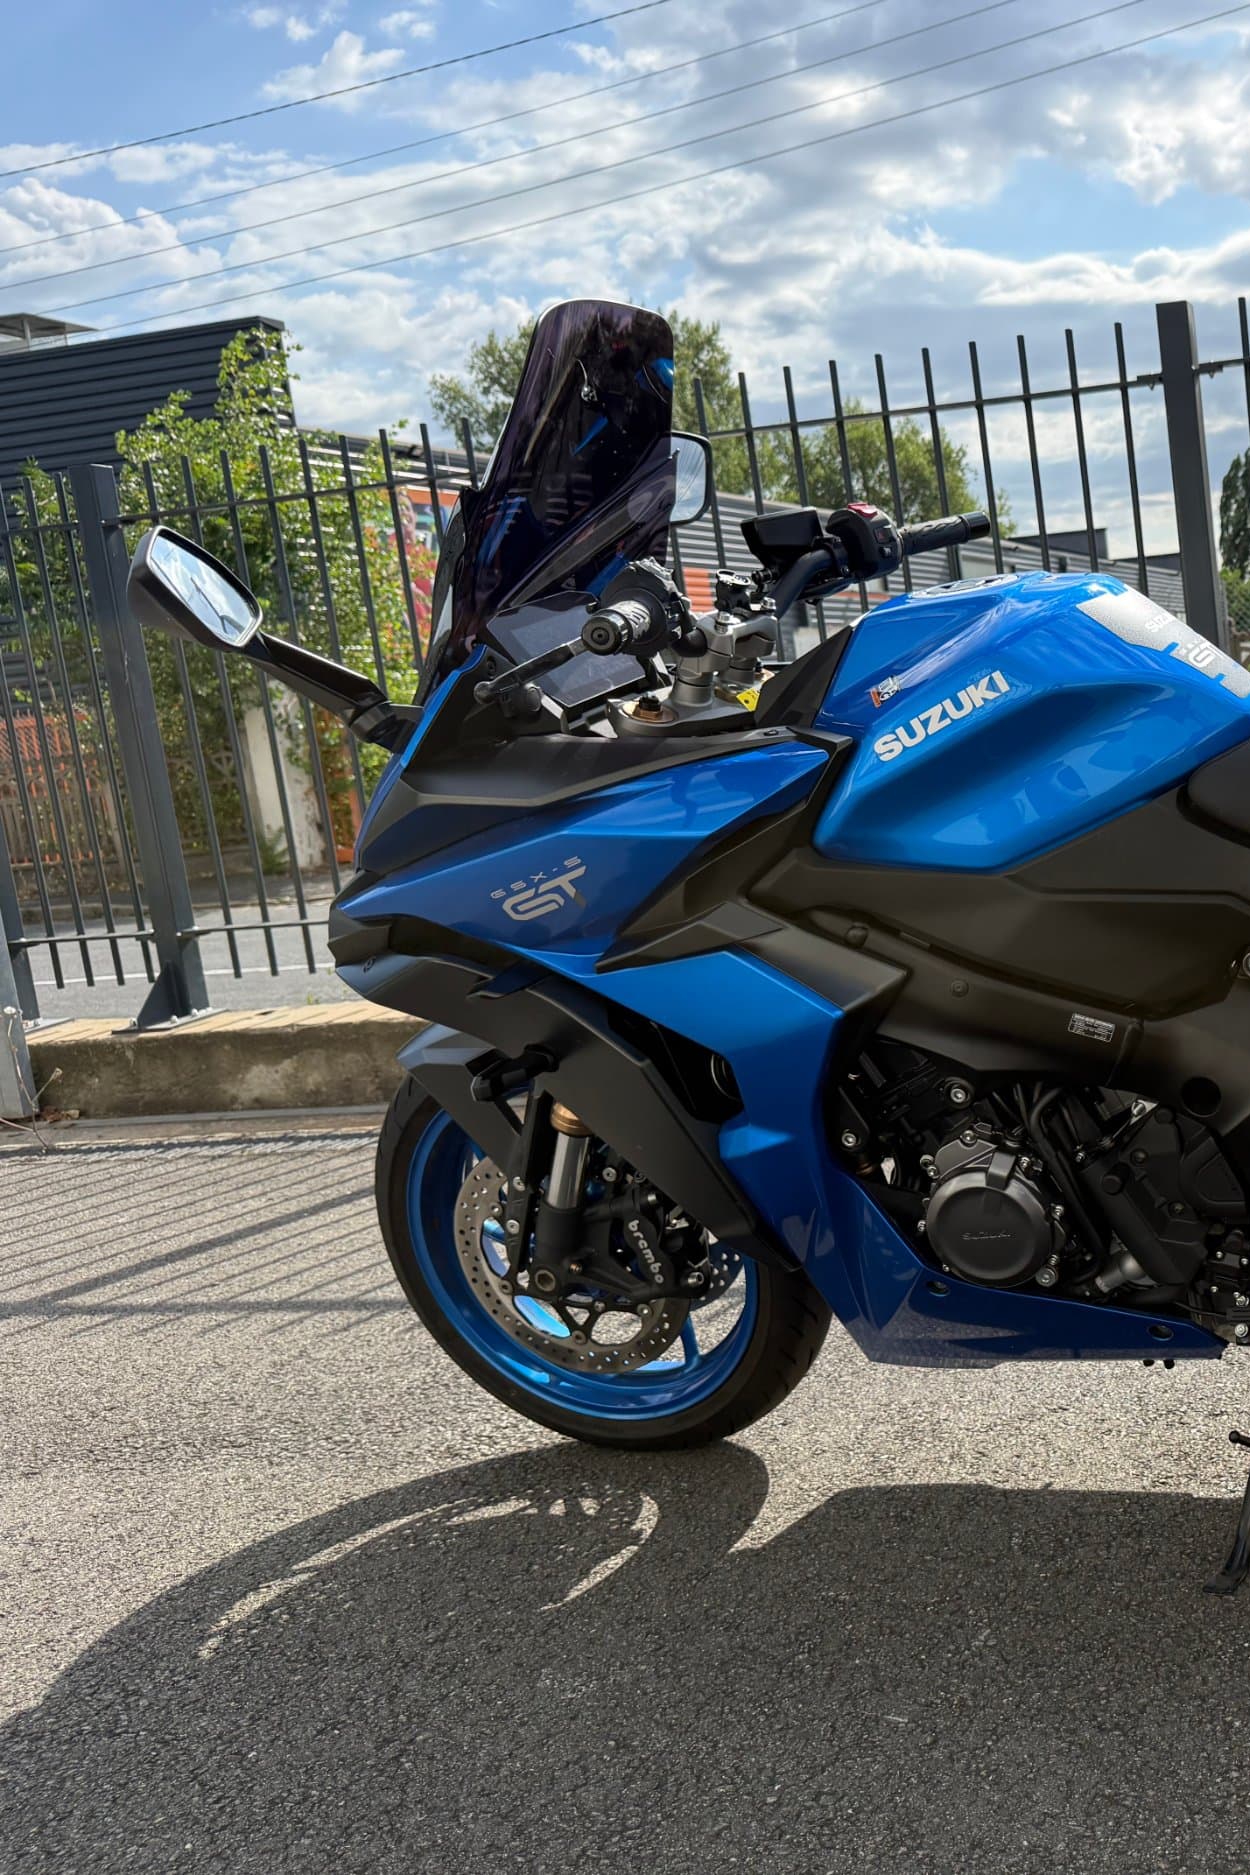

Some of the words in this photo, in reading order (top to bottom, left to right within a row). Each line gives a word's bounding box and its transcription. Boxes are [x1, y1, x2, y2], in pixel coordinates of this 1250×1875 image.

[873, 669, 1010, 762] SUZUKI
[490, 855, 582, 899] GSX-S
[502, 865, 587, 921] GT
[627, 1219, 664, 1284] brembo
